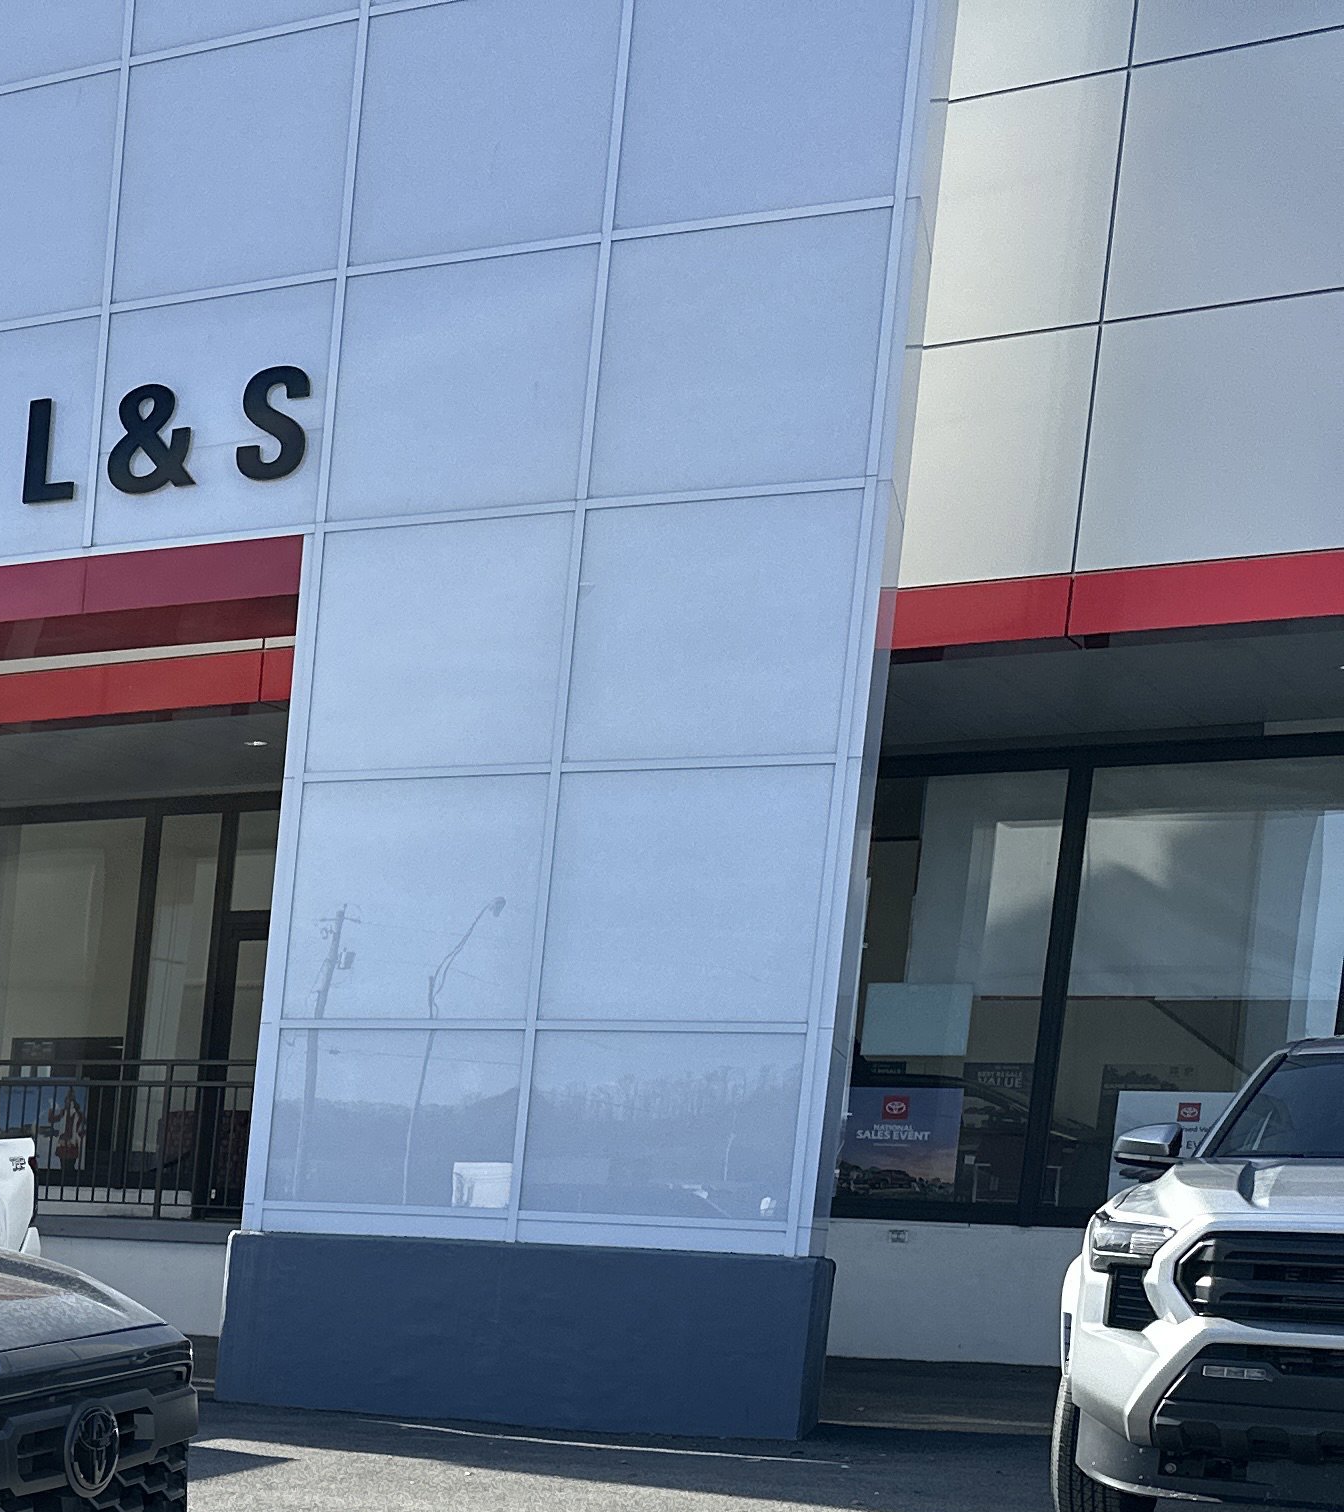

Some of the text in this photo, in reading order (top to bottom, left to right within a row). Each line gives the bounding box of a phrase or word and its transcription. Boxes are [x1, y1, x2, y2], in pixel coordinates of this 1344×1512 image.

[22, 365, 311, 504] L & S
[856, 1129, 931, 1141] SALES EVENT
